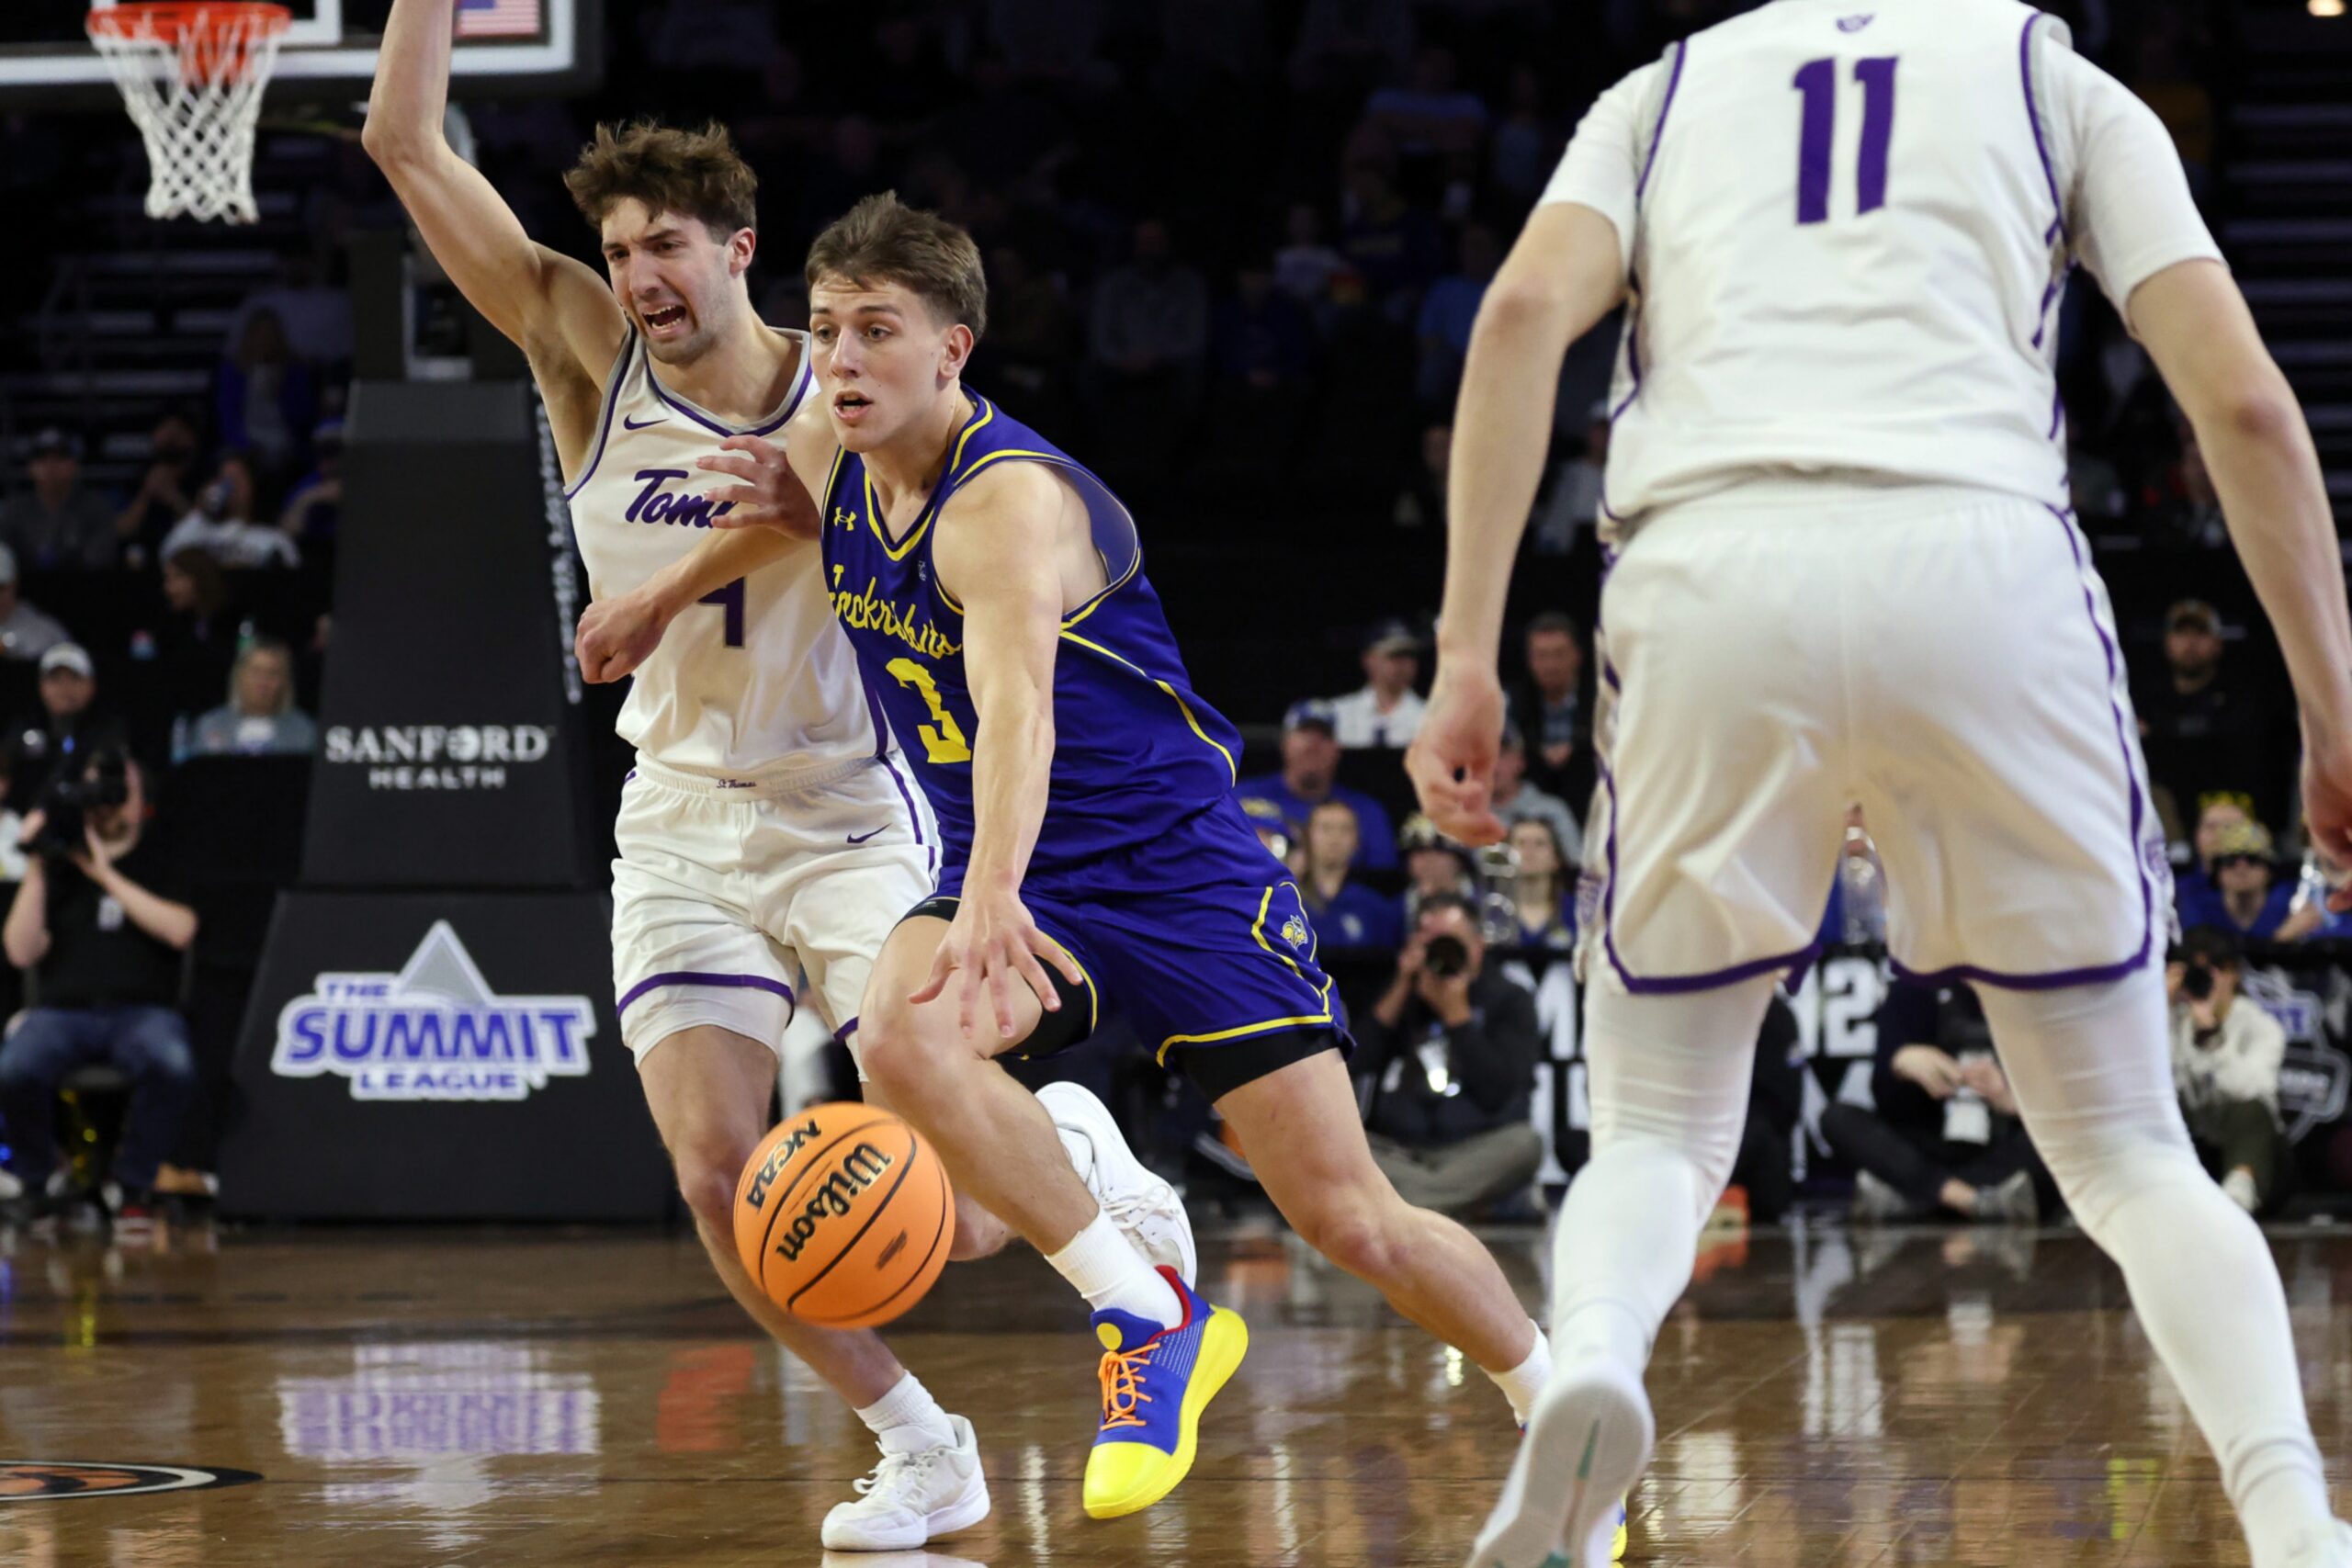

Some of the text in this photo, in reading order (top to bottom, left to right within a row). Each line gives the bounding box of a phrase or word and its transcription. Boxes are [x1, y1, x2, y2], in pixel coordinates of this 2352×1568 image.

[1792, 56, 1899, 225] 11
[885, 657, 972, 764] 3
[324, 725, 549, 763] SANFORD
[368, 766, 506, 790] HEALTH
[327, 983, 390, 998] THE
[289, 1010, 578, 1060] SUMMIT
[360, 1073, 517, 1089] LEAGUE
[746, 1118, 821, 1211] NCAA
[775, 1142, 896, 1263] Wilson
